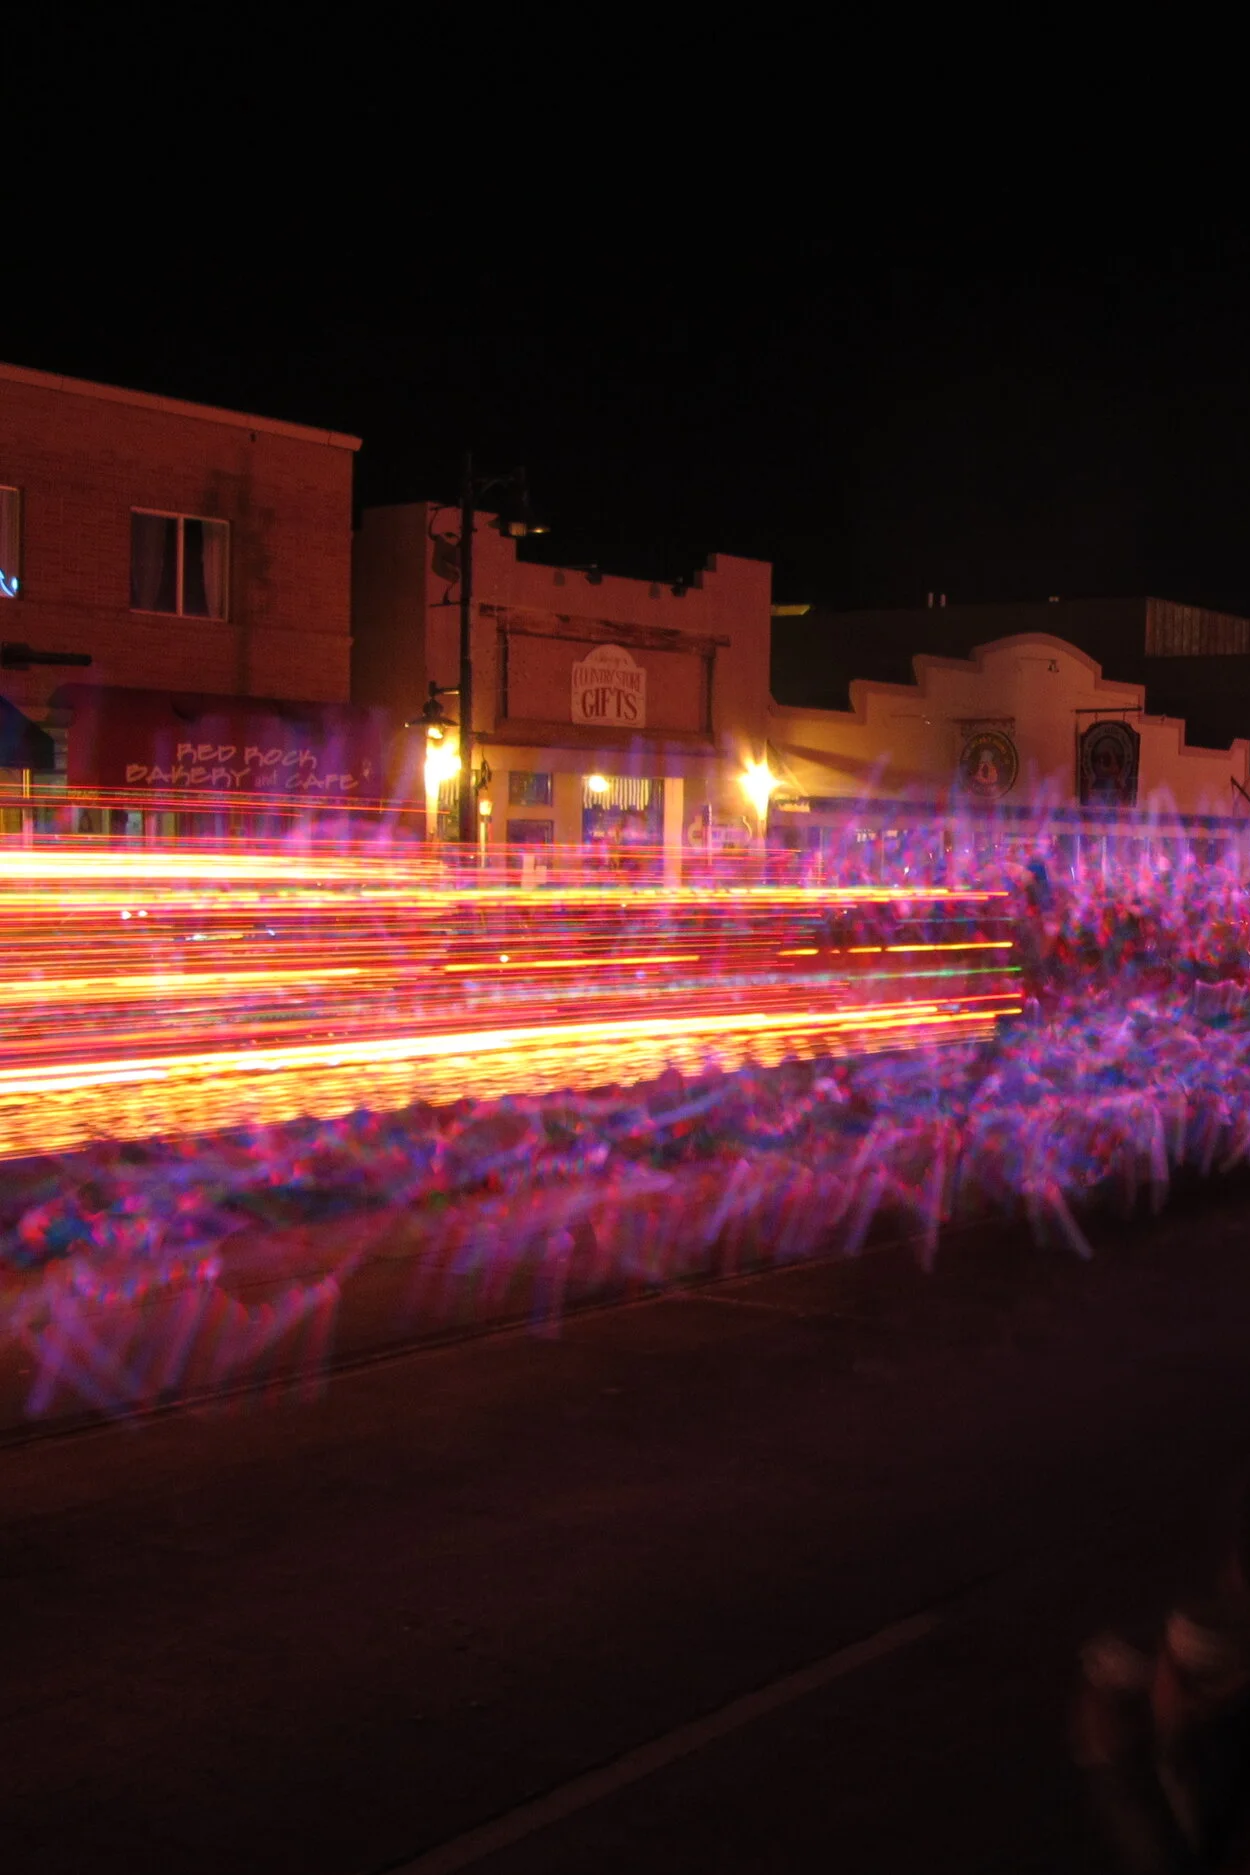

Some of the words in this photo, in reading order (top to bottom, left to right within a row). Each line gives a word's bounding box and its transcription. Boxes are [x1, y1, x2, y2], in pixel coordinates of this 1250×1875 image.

[582, 687, 638, 720] GIFTS
[177, 743, 237, 765] RED
[243, 746, 317, 769] ROCK
[125, 763, 250, 788] BAKERY
[255, 769, 279, 788] and
[285, 774, 359, 791] CAFE
